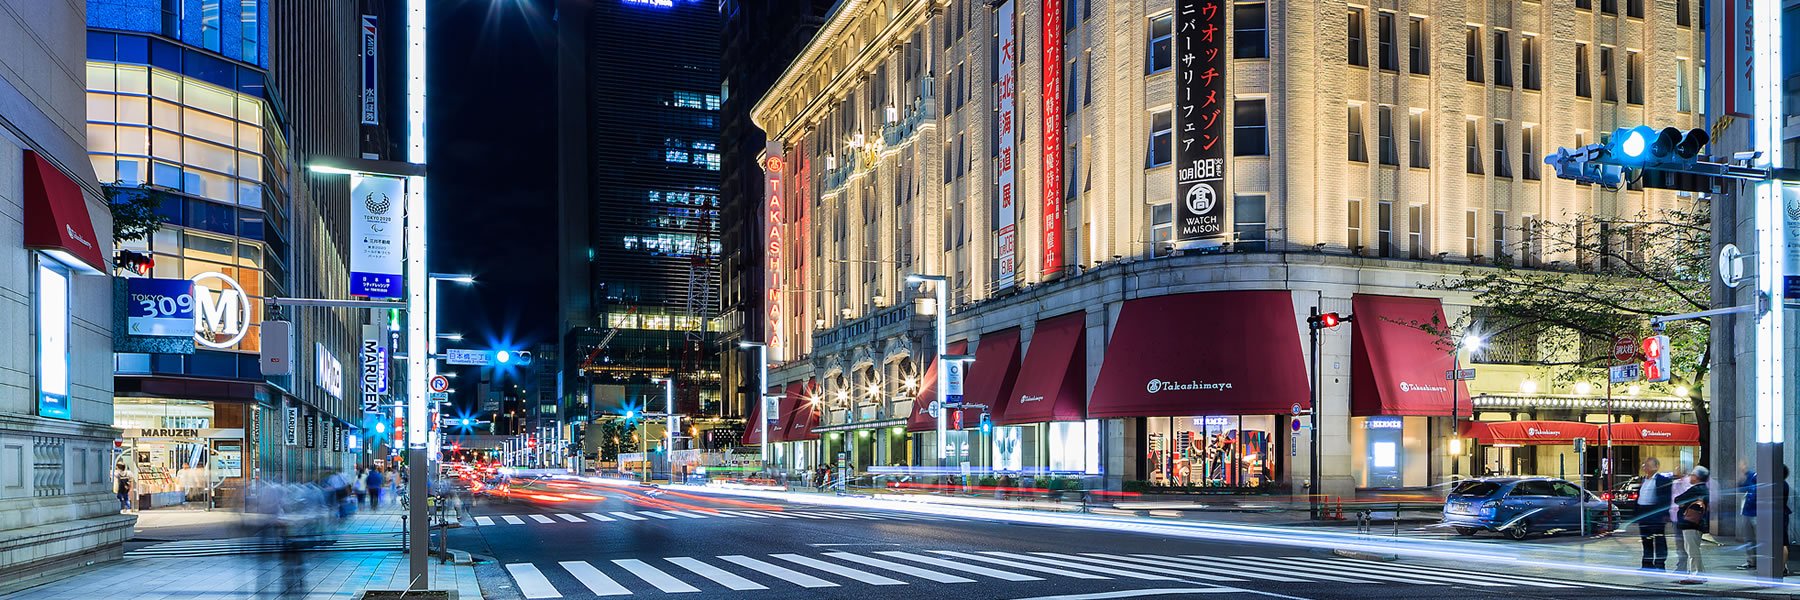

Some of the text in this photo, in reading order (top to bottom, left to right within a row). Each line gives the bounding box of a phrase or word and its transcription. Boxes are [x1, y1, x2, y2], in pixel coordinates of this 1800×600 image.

[1186, 215, 1217, 226] WATCH
[1183, 224, 1220, 235] MAISON
[769, 179, 782, 348] TAKASHIMAYA
[131, 293, 164, 302] TOKYO
[140, 294, 194, 318] 309
[195, 286, 240, 335] M
[365, 341, 377, 412] MARUZEN
[1162, 381, 1233, 392] Takashimaya
[1408, 383, 1447, 393] Takashimaya
[141, 428, 199, 438] MARUZEN
